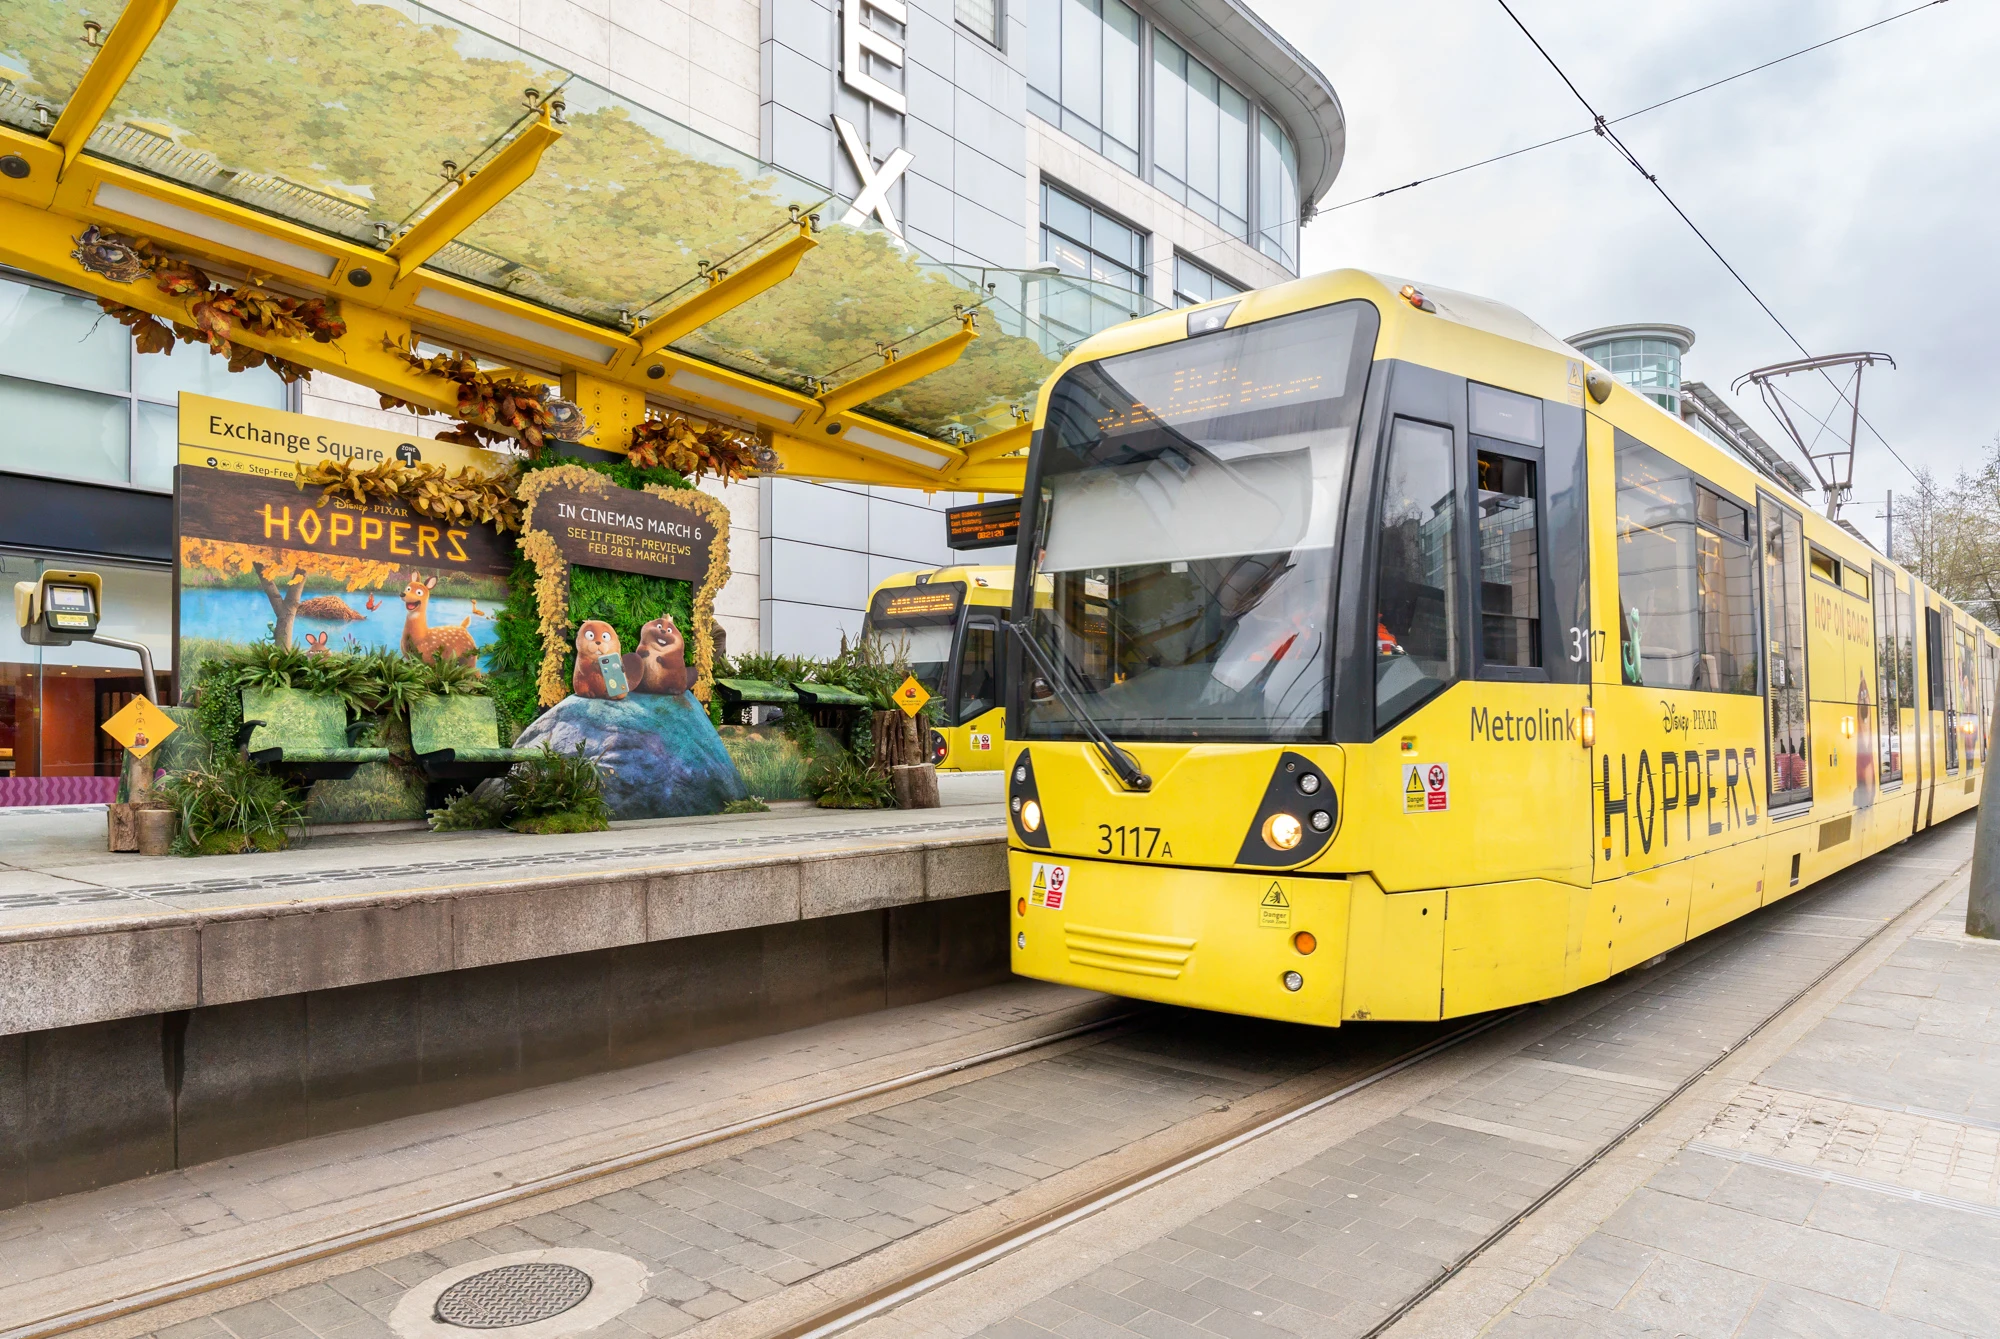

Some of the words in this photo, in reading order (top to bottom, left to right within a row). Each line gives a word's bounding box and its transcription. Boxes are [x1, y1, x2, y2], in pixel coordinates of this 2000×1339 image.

[209, 415, 310, 453] Exchange
[316, 435, 384, 463] Square
[401, 445, 416, 453] ZONE
[249, 464, 294, 479] Step-Free
[403, 452, 412, 466] 1
[374, 505, 408, 517] PIXAR
[558, 503, 576, 519] IN
[581, 507, 644, 530] CINEMAS
[648, 519, 691, 539] MARCH
[694, 527, 702, 540] 6
[263, 503, 469, 562] HOPPERS
[567, 527, 588, 540] SEE
[590, 530, 602, 541] IT
[641, 539, 691, 556] PREVIEWS
[588, 542, 608, 555] FEB
[610, 546, 624, 557] 28
[626, 548, 633, 558] &
[636, 550, 668, 564] MARCH
[671, 555, 676, 565] 1
[1814, 592, 1831, 632] HOP
[1834, 602, 1844, 637] ON
[1846, 607, 1870, 647] BOARD
[1569, 626, 1606, 663] 3117
[1471, 706, 1577, 742] Metrolink
[1692, 709, 1718, 730] PIXAR
[1602, 747, 1758, 861] HOPPERS
[1263, 911, 1287, 920] Danger
